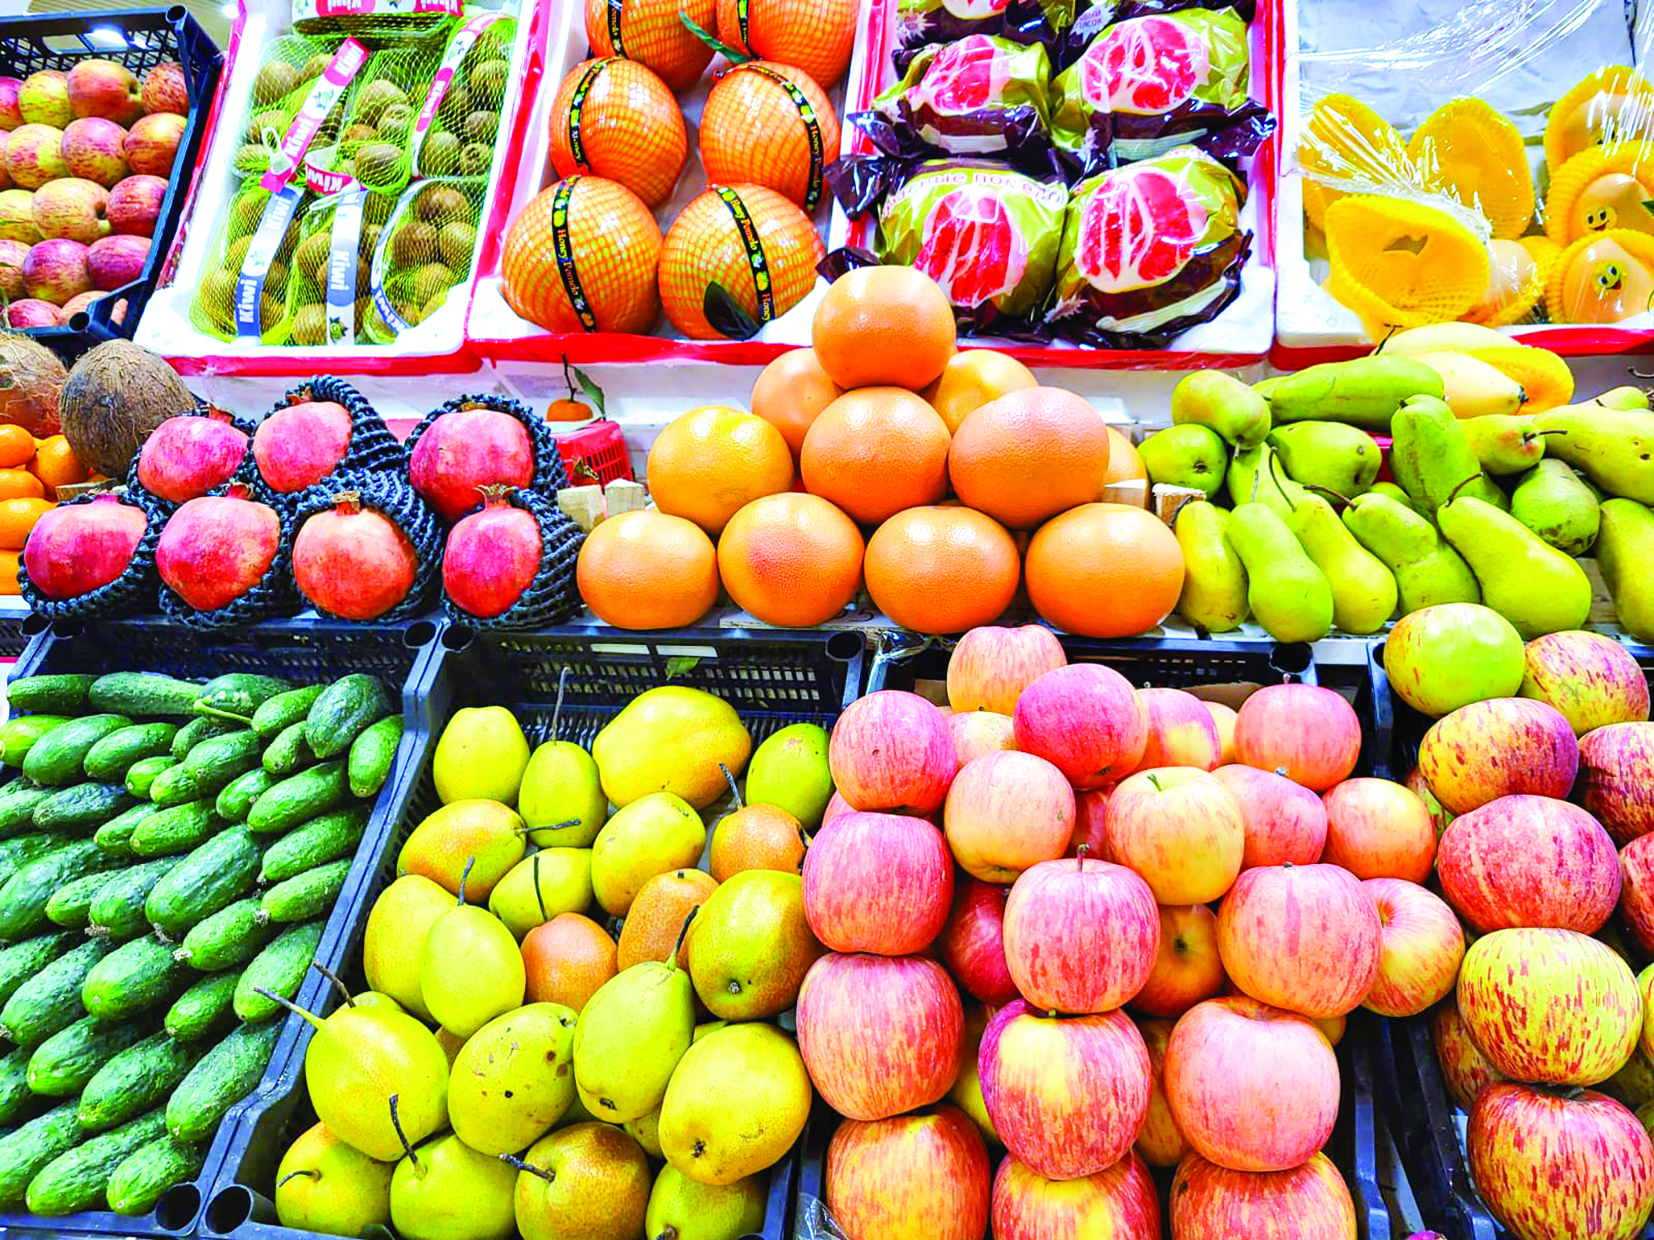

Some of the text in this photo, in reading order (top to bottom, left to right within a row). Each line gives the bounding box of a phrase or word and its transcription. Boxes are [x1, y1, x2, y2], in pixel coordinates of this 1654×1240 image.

[333, 41, 365, 77] Kiwi
[283, 117, 315, 157] Kiwi
[264, 195, 293, 231] Kiwi
[740, 217, 759, 251] Pomelo
[330, 250, 351, 291] Kiwi
[556, 228, 579, 296] Honey Pomelo
[237, 279, 258, 323] Kiwi
[761, 293, 771, 321] Honey
